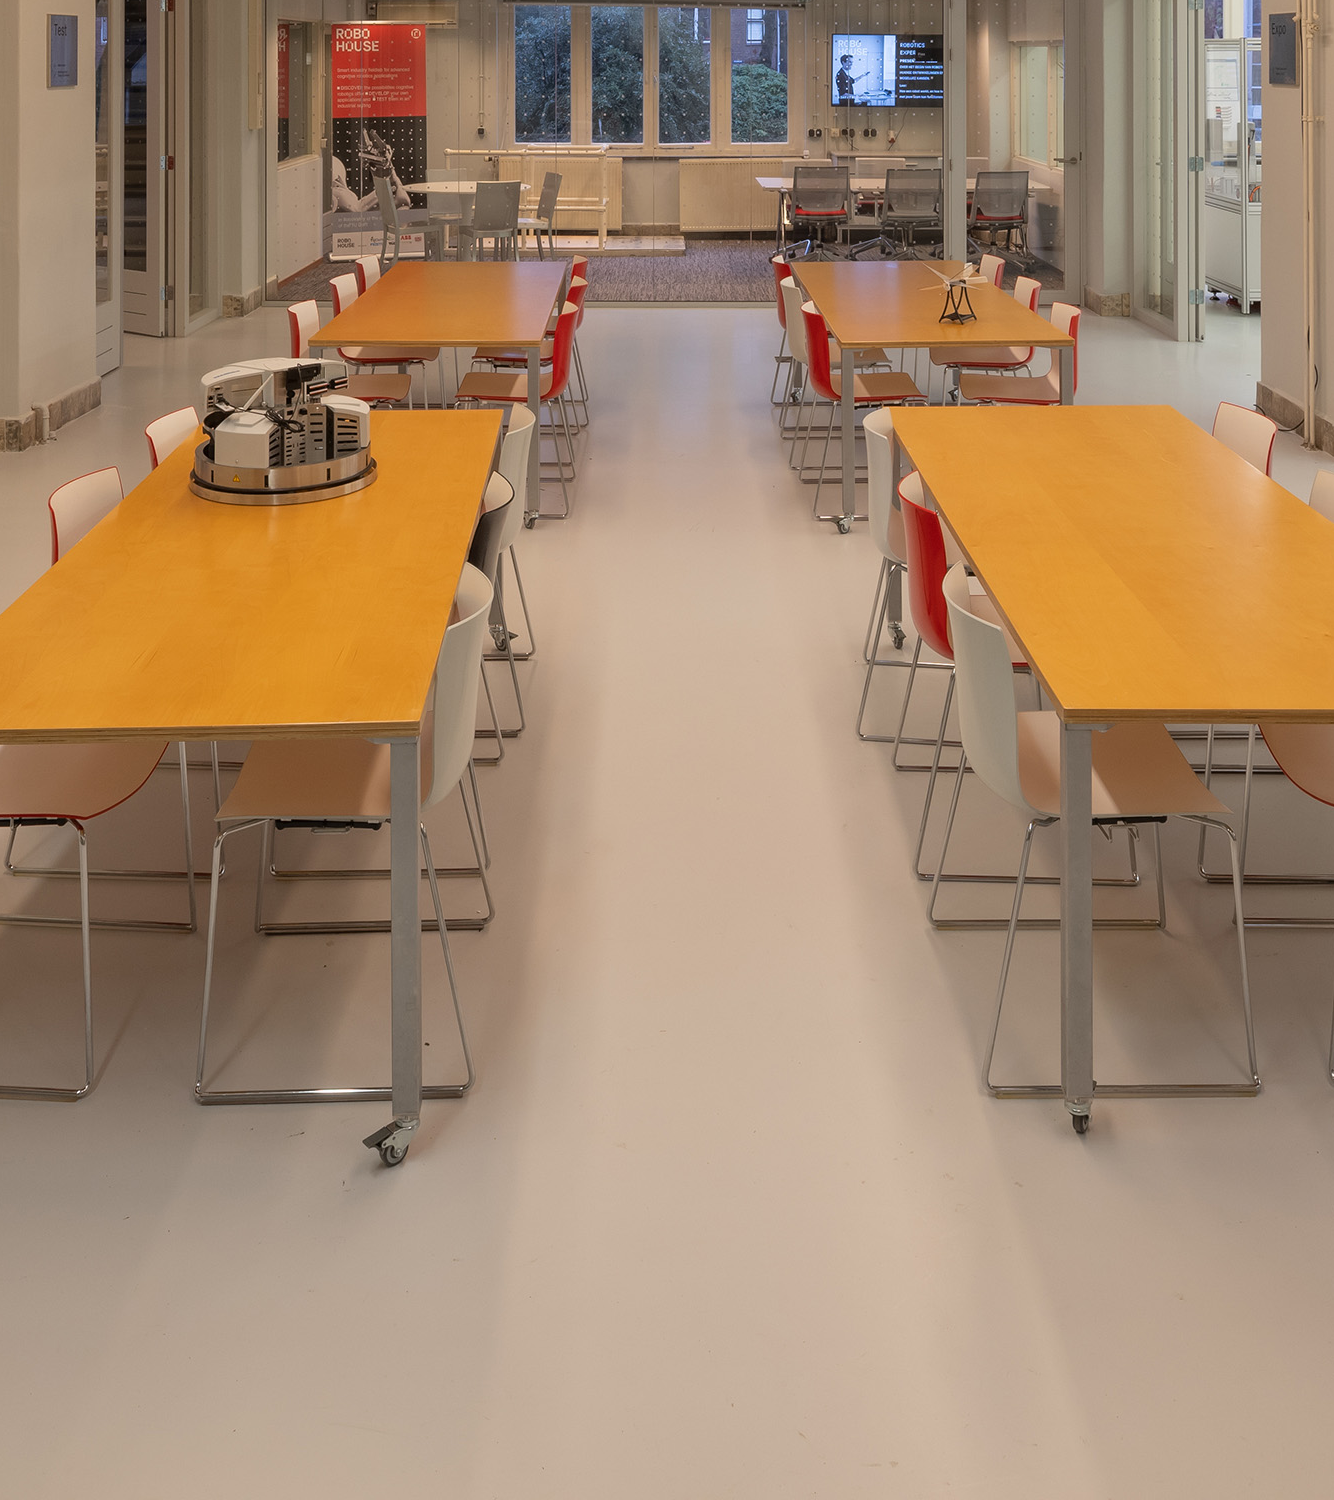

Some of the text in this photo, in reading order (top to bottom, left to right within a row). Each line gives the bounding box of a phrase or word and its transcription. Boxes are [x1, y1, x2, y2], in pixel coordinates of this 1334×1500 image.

[54, 23, 67, 36] Test
[336, 28, 370, 39] ROBO
[1272, 22, 1286, 36] Expo
[336, 40, 379, 52] HOUSE
[838, 39, 862, 48] ROBO
[838, 48, 868, 56] HOUSE
